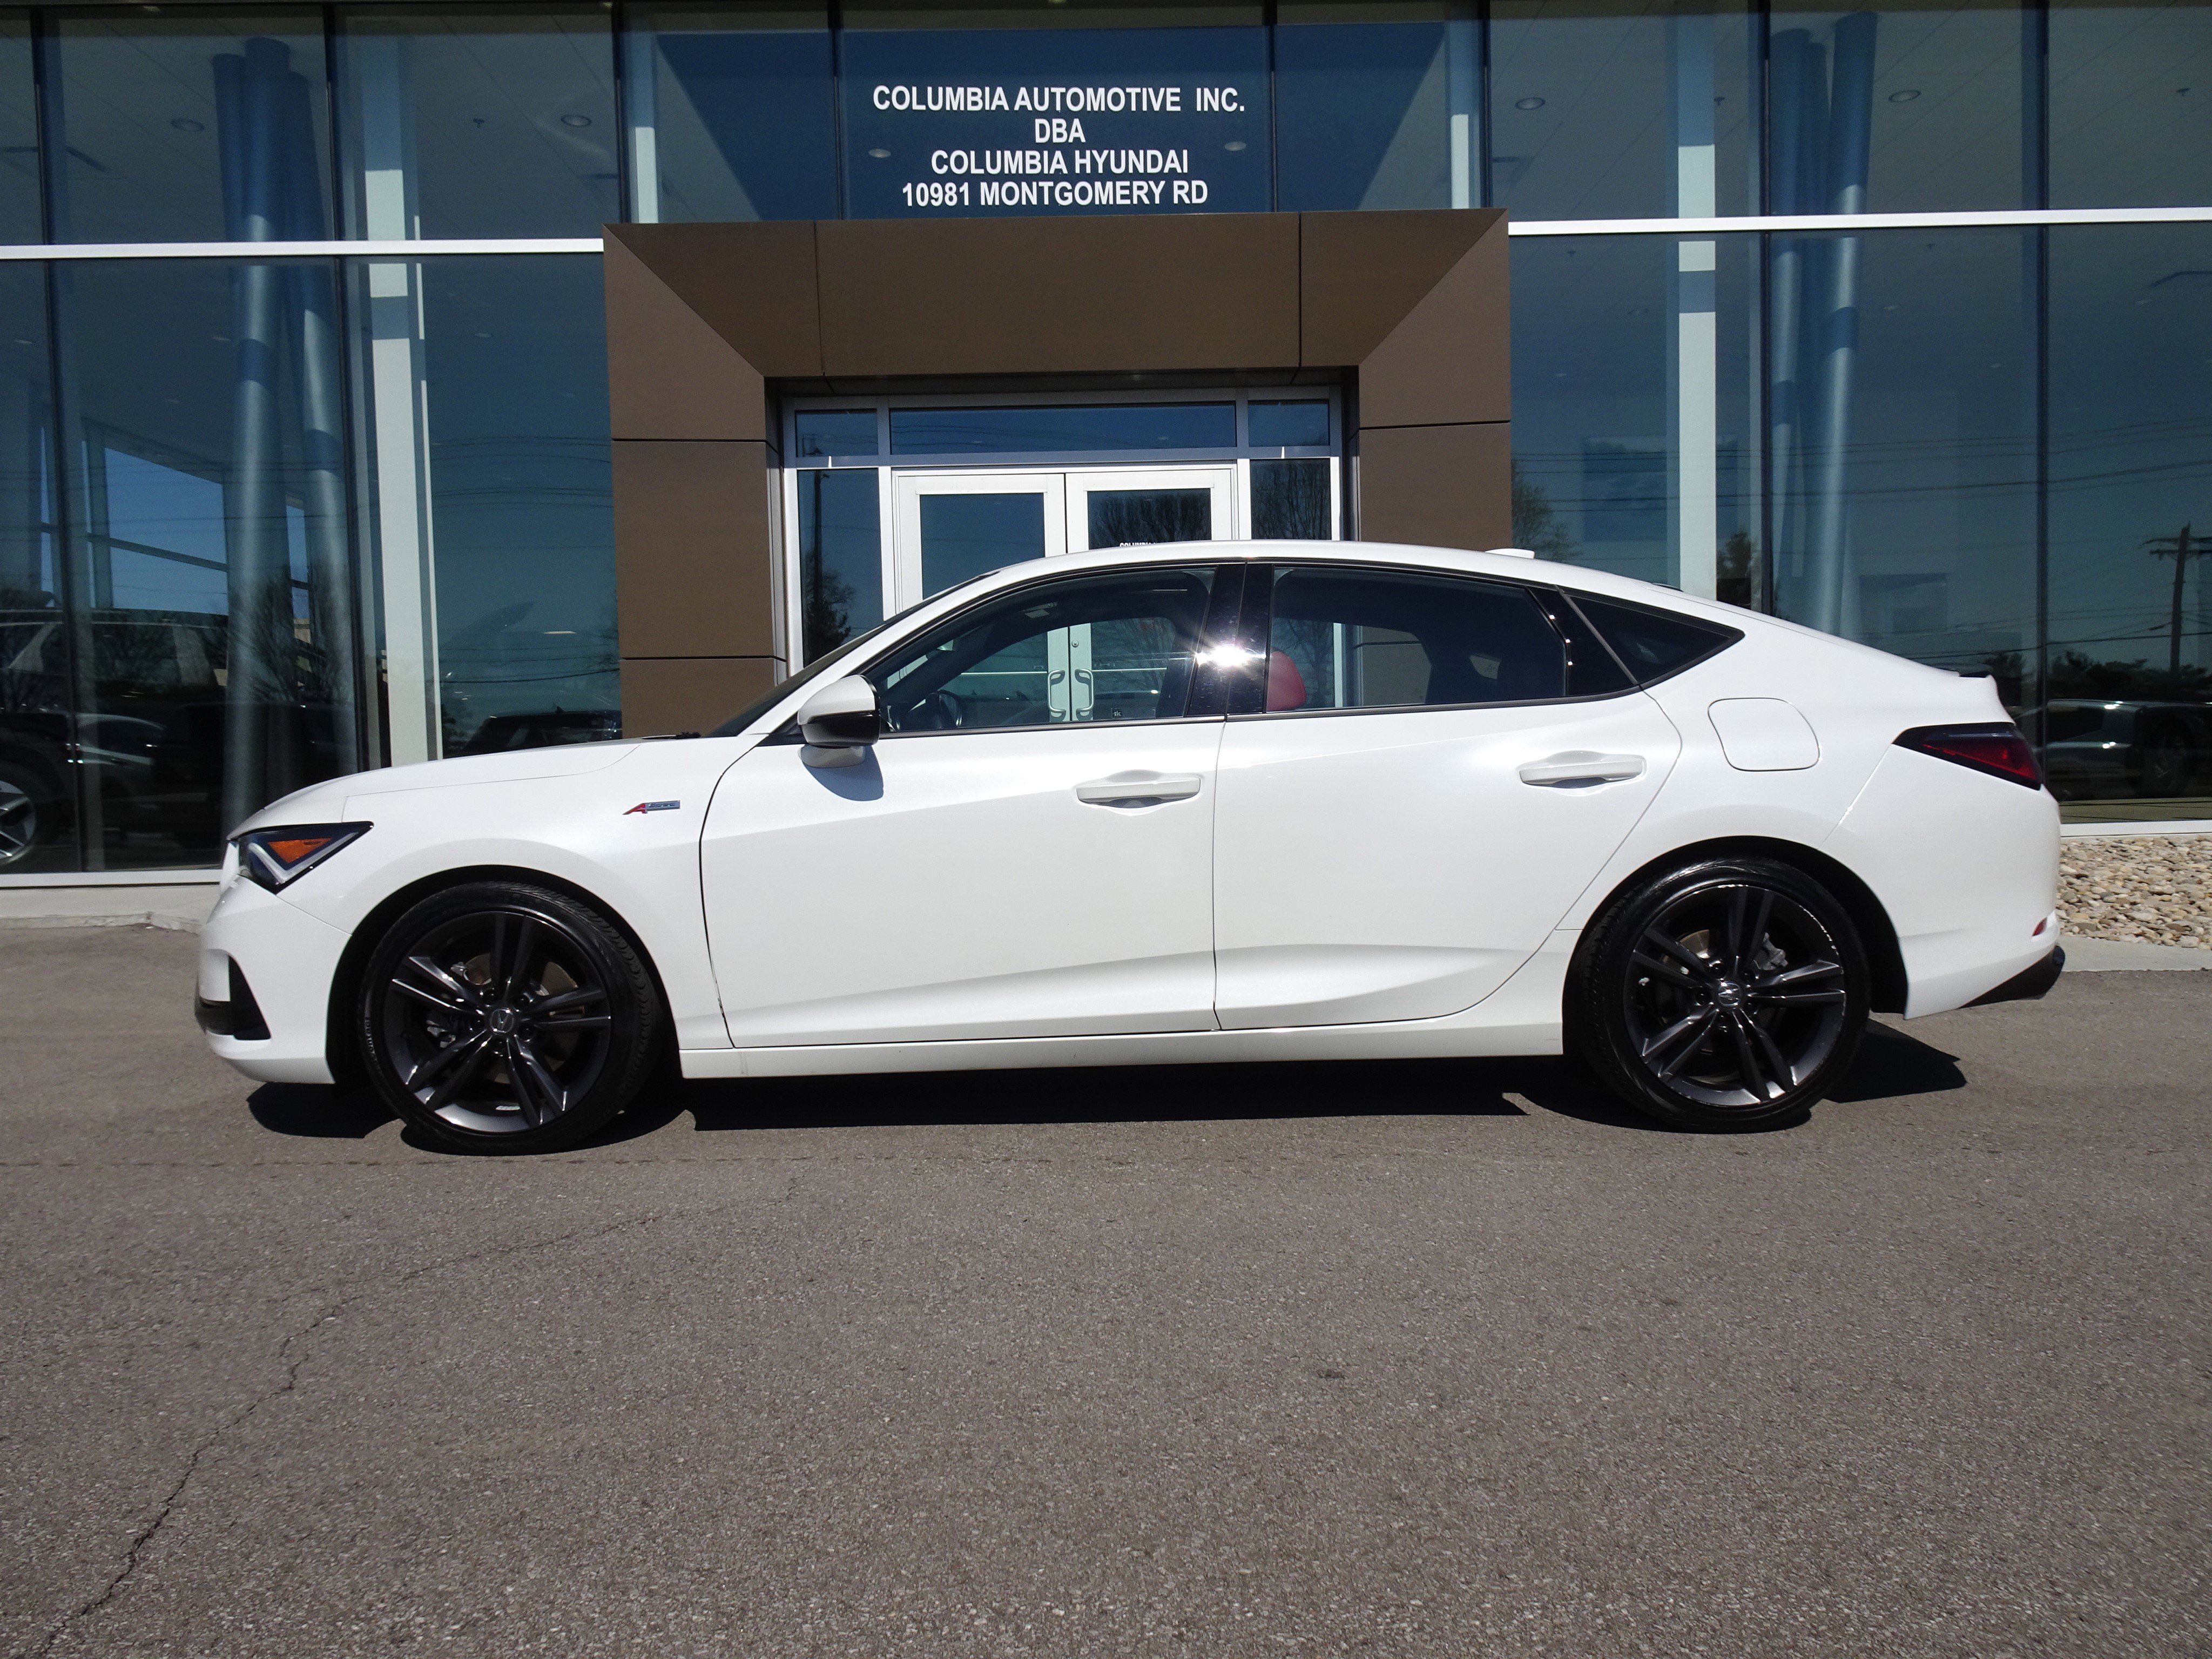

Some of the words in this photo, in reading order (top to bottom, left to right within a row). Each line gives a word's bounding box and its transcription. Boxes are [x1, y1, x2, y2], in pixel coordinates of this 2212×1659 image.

[873, 85, 1009, 111] COLUMBIA
[1014, 87, 1182, 112] AUTOMOTIVE
[1196, 87, 1245, 112] INC.
[1034, 118, 1086, 143] DBA
[930, 150, 1068, 174] COLUMBIA
[1075, 149, 1189, 174] HYUNDAI
[902, 182, 969, 207] 10981
[980, 180, 1165, 206] MONTGOMERY
[1172, 180, 1209, 204] RD
